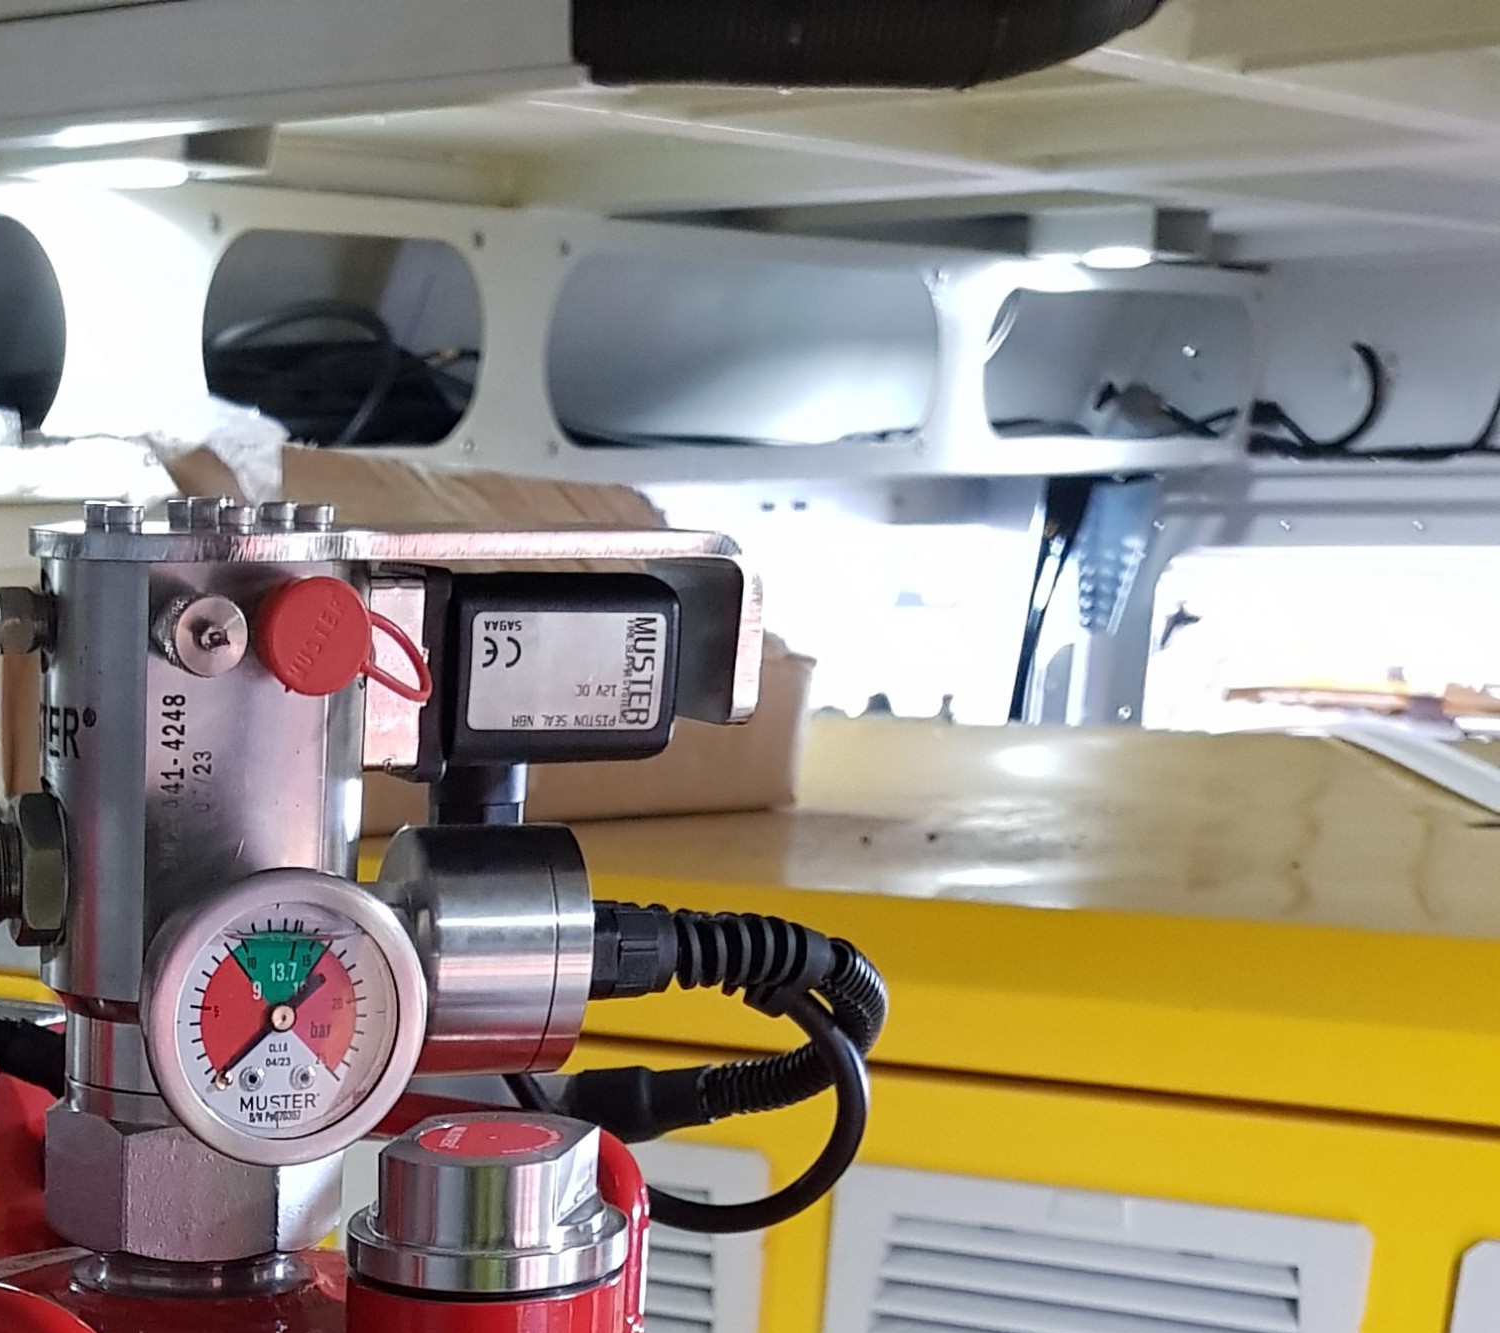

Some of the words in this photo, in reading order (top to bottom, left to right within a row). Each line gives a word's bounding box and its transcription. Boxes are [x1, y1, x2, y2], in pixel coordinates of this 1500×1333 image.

[482, 637, 521, 668] CE
[625, 617, 658, 726] MUSTER
[576, 684, 590, 697] DC
[596, 684, 617, 697] 12V
[511, 714, 535, 727] NBR
[541, 714, 568, 727] SEAL
[574, 714, 616, 727] PISTON
[246, 957, 257, 970] 10
[302, 955, 312, 967] 15
[269, 962, 298, 982] 13.7
[253, 981, 263, 1000] 9
[331, 997, 344, 1009] 20
[212, 1007, 220, 1018] 5
[310, 1021, 332, 1038] bar
[265, 1056, 291, 1068] 04/23
